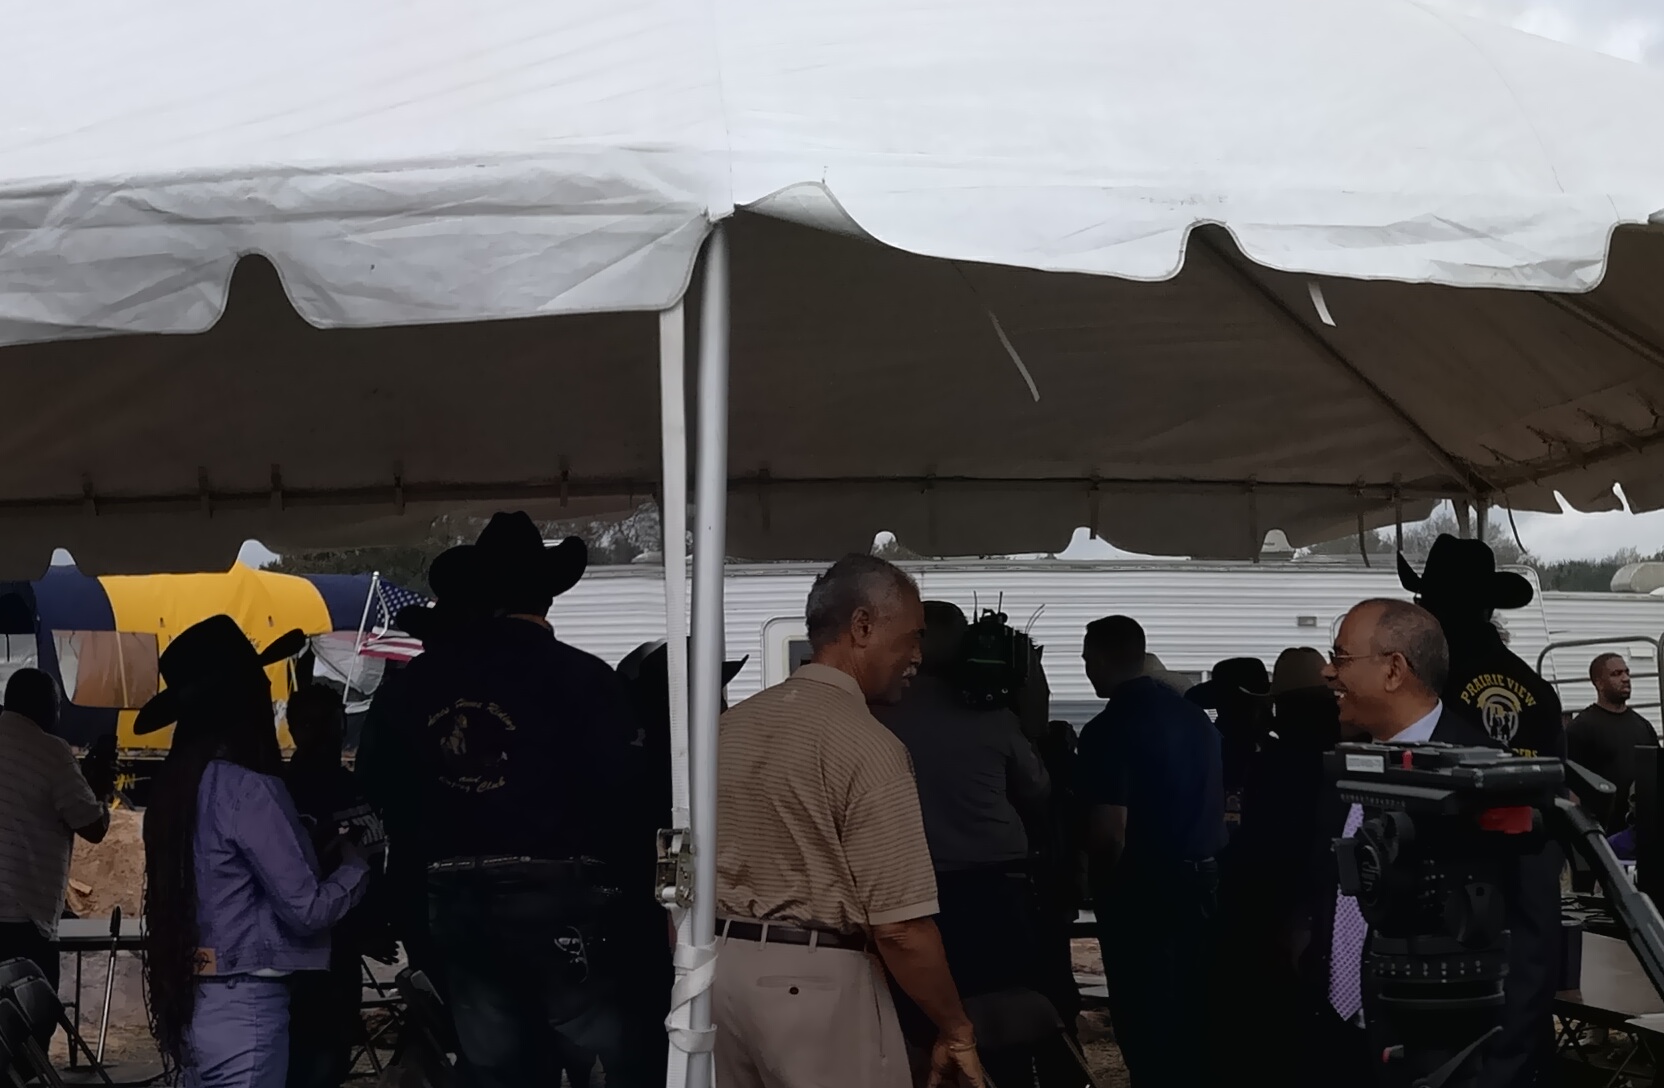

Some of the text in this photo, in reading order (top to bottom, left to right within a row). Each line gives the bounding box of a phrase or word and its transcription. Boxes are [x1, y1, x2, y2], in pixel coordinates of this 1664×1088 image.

[1460, 673, 1537, 707] PRAIRIE VIEW
[476, 776, 506, 793] Club
